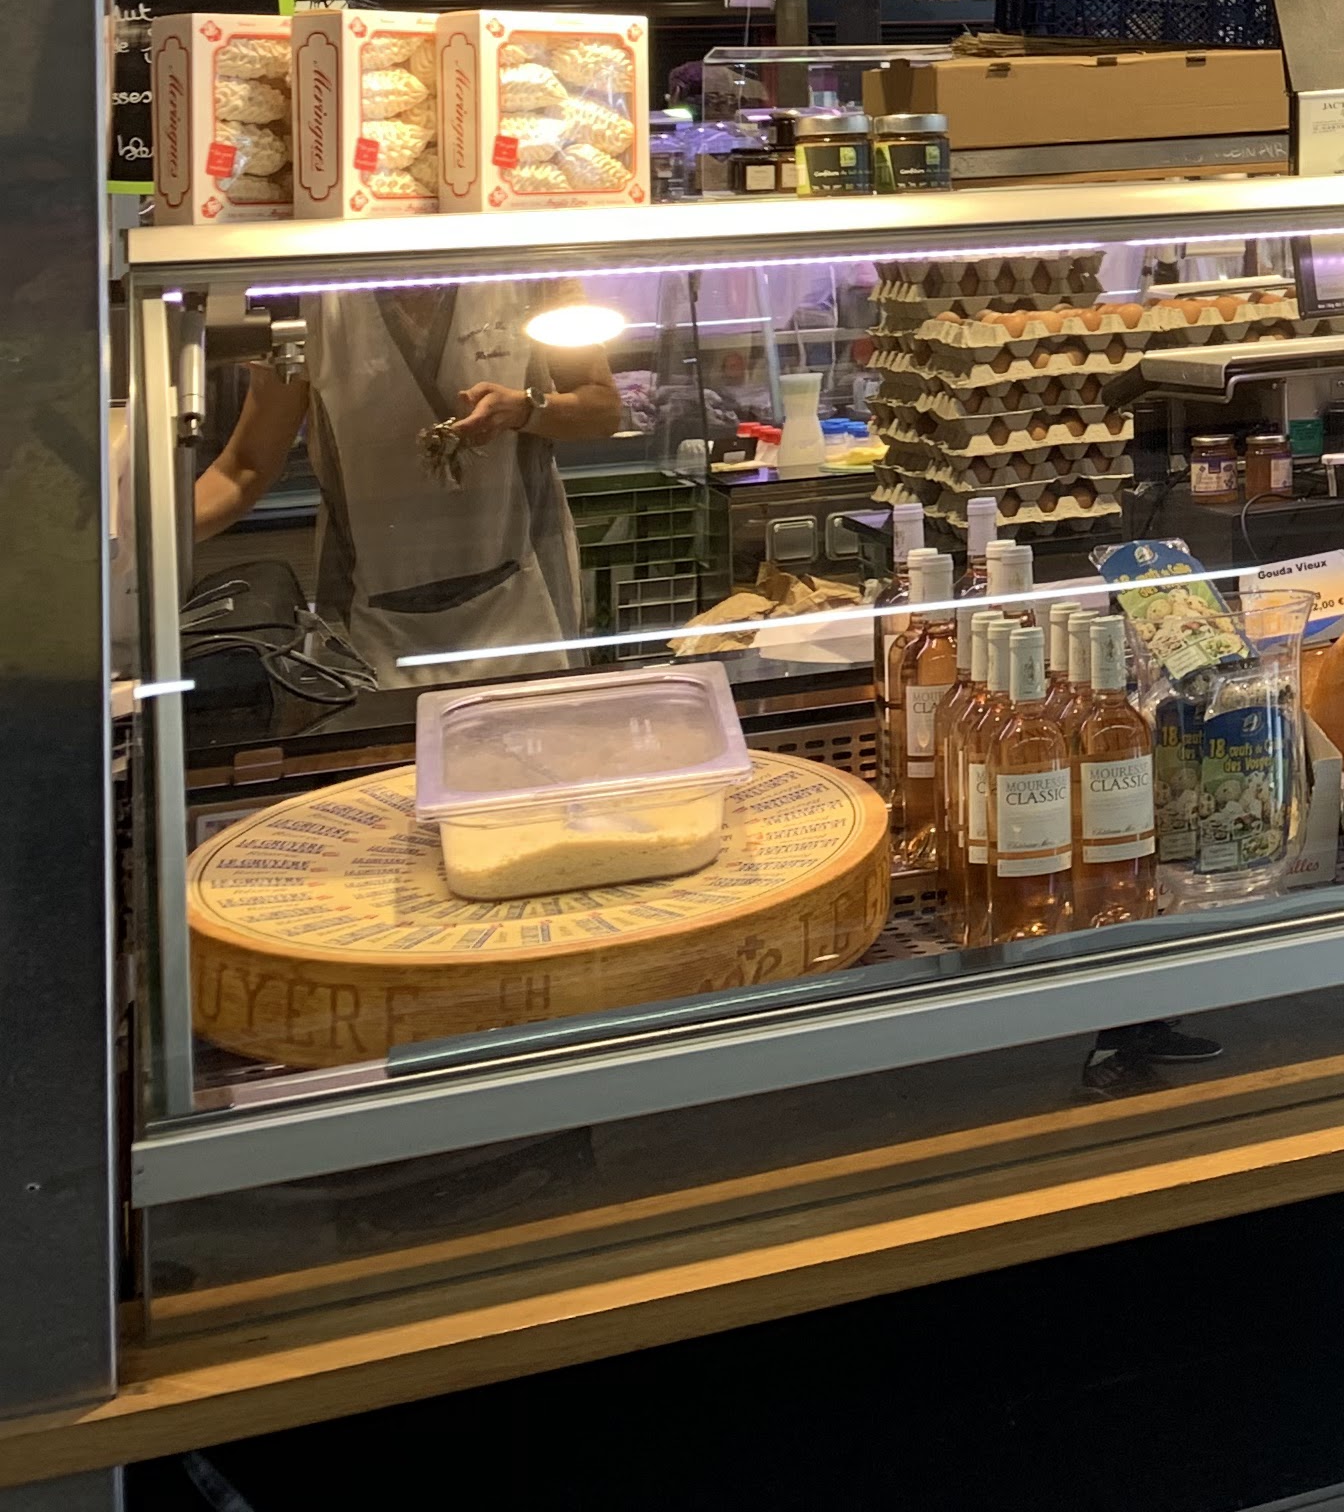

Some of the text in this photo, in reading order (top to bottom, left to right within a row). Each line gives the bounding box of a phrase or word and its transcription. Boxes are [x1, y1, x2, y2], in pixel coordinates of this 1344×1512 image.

[307, 59, 333, 173] Meringues
[1257, 559, 1328, 580] Gouda Vieux
[912, 690, 945, 702] MOUR
[1161, 725, 1179, 747] 18
[1208, 738, 1227, 759] 18
[1089, 772, 1150, 794] CLASSIC
[1005, 786, 1067, 806] CLASSIC
